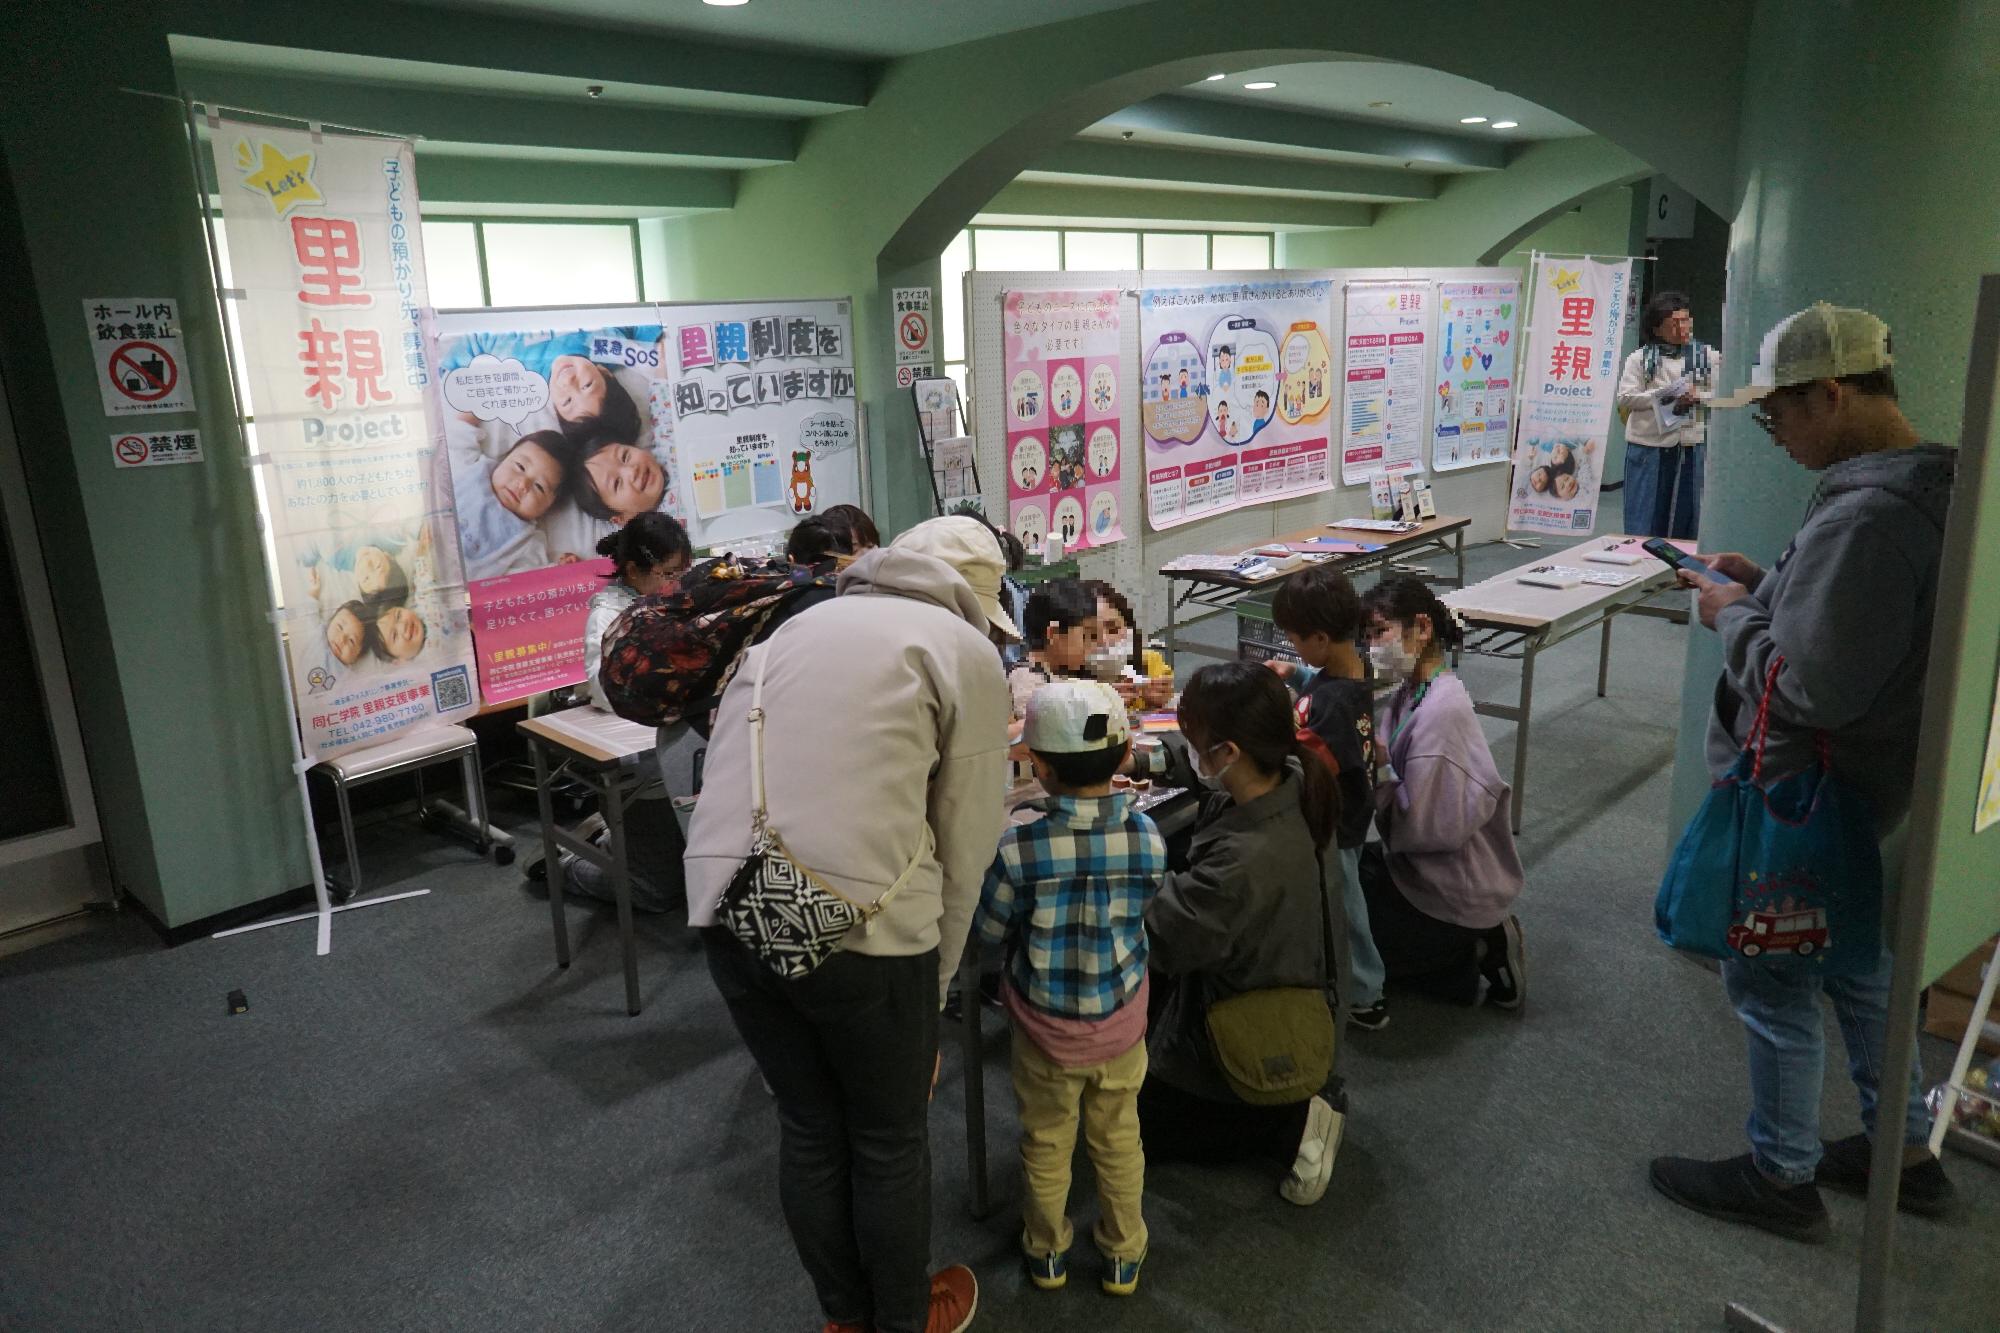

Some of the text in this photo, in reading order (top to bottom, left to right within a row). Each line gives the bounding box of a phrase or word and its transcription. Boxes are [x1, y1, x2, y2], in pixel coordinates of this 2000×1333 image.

[266, 170, 305, 197] Let's
[1658, 194, 1668, 220] C
[93, 304, 173, 321] ホール内
[290, 216, 393, 409] 里親
[897, 301, 929, 311] 食事禁止
[96, 323, 177, 341] 飲食禁止
[681, 318, 840, 368] 里親制度を
[1549, 297, 1595, 381] 里親
[912, 366, 932, 378] 禁煙
[675, 369, 854, 415] 知っていますか
[1543, 383, 1593, 397] Project
[303, 414, 404, 443] Project
[149, 434, 197, 452] 禁煙
[312, 705, 361, 730] 同仁学院
[362, 684, 432, 716] 里親支援事業
